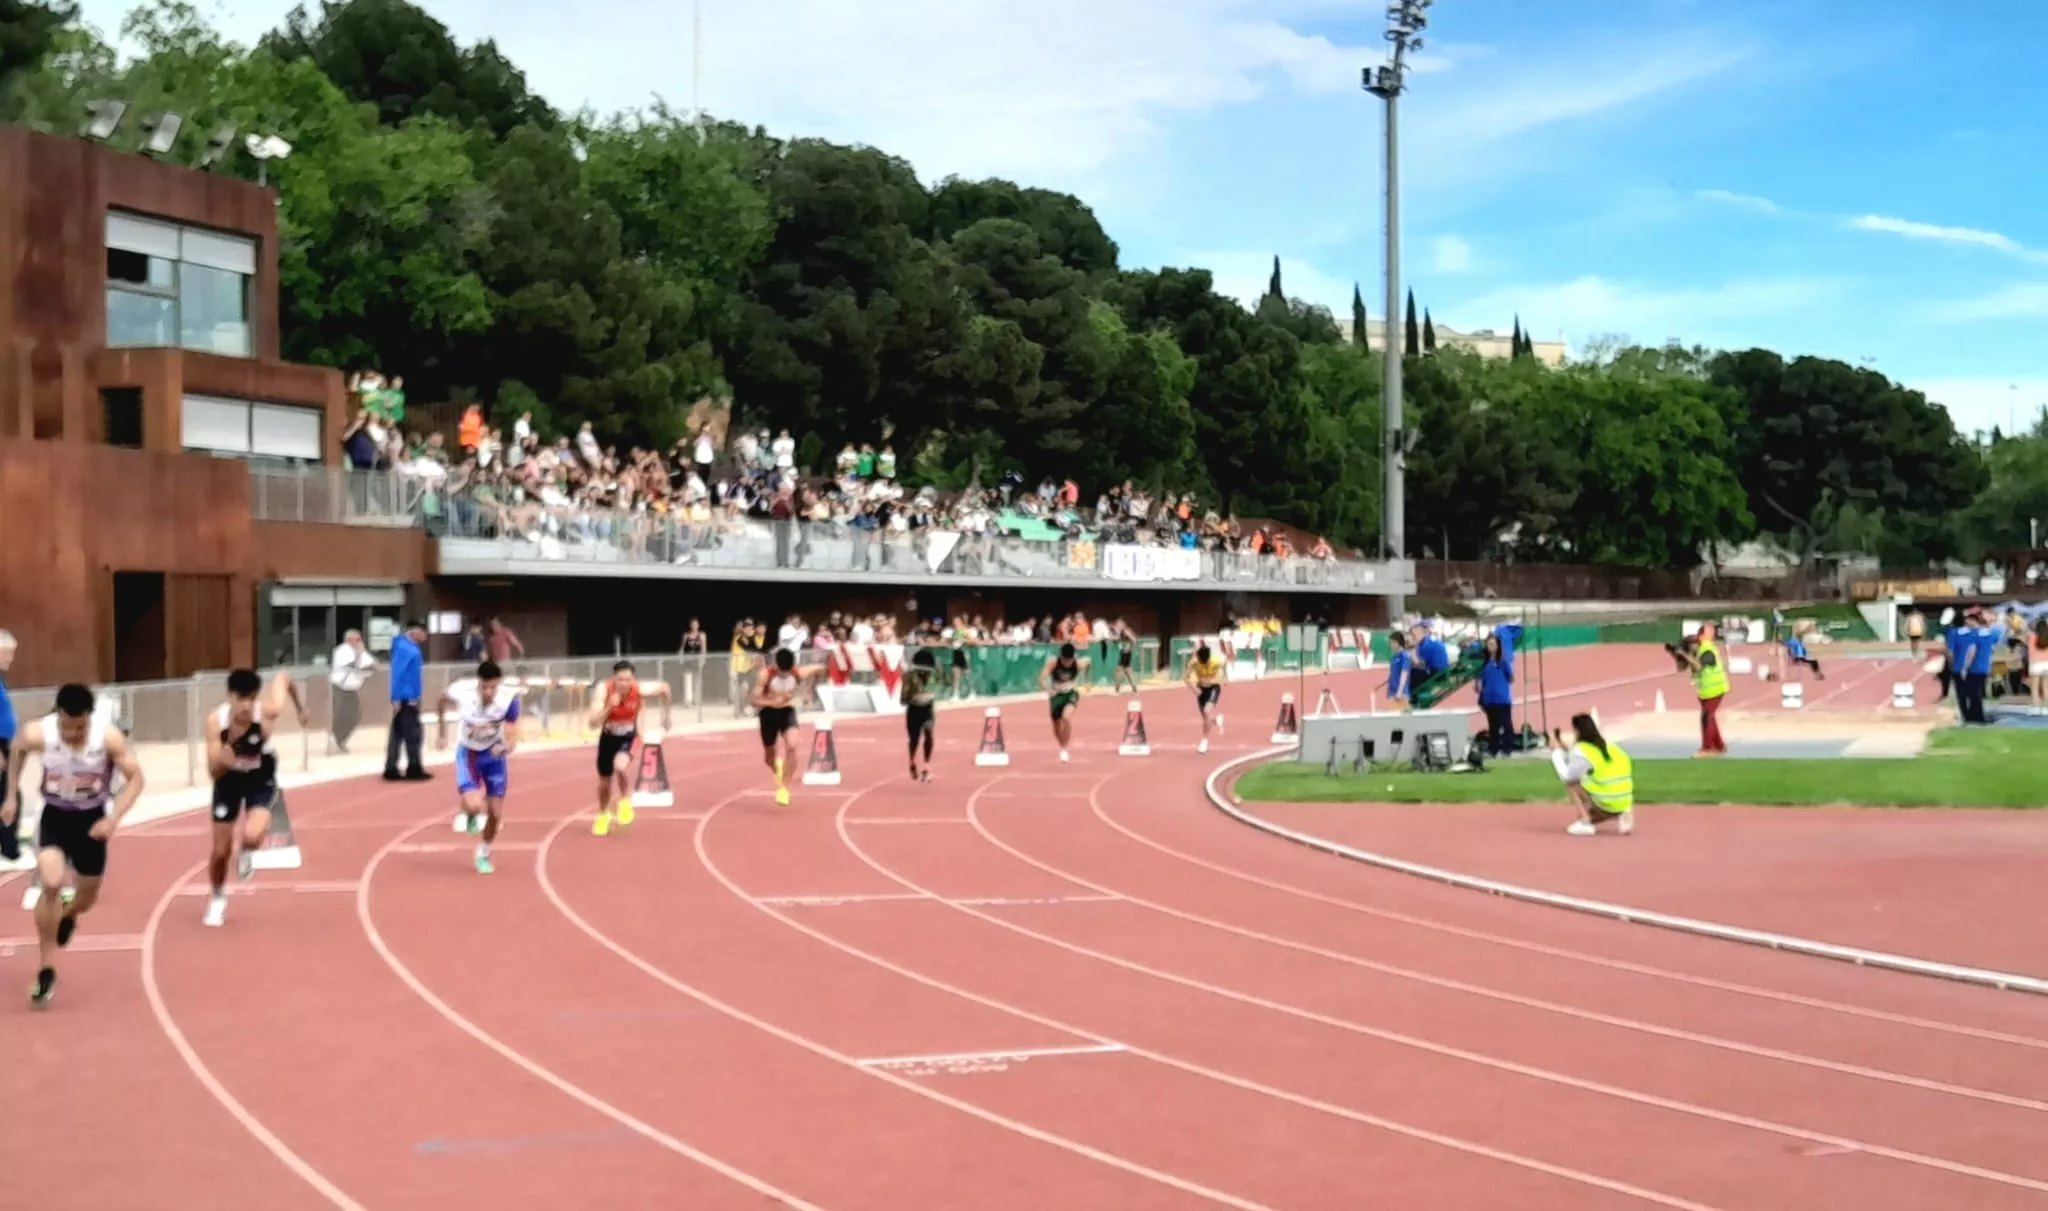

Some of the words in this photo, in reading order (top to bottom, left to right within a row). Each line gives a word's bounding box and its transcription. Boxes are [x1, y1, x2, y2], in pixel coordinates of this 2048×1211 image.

[986, 718, 997, 742] 3
[1129, 711, 1139, 735] 2
[815, 731, 827, 758] 4
[643, 746, 658, 779] 5
